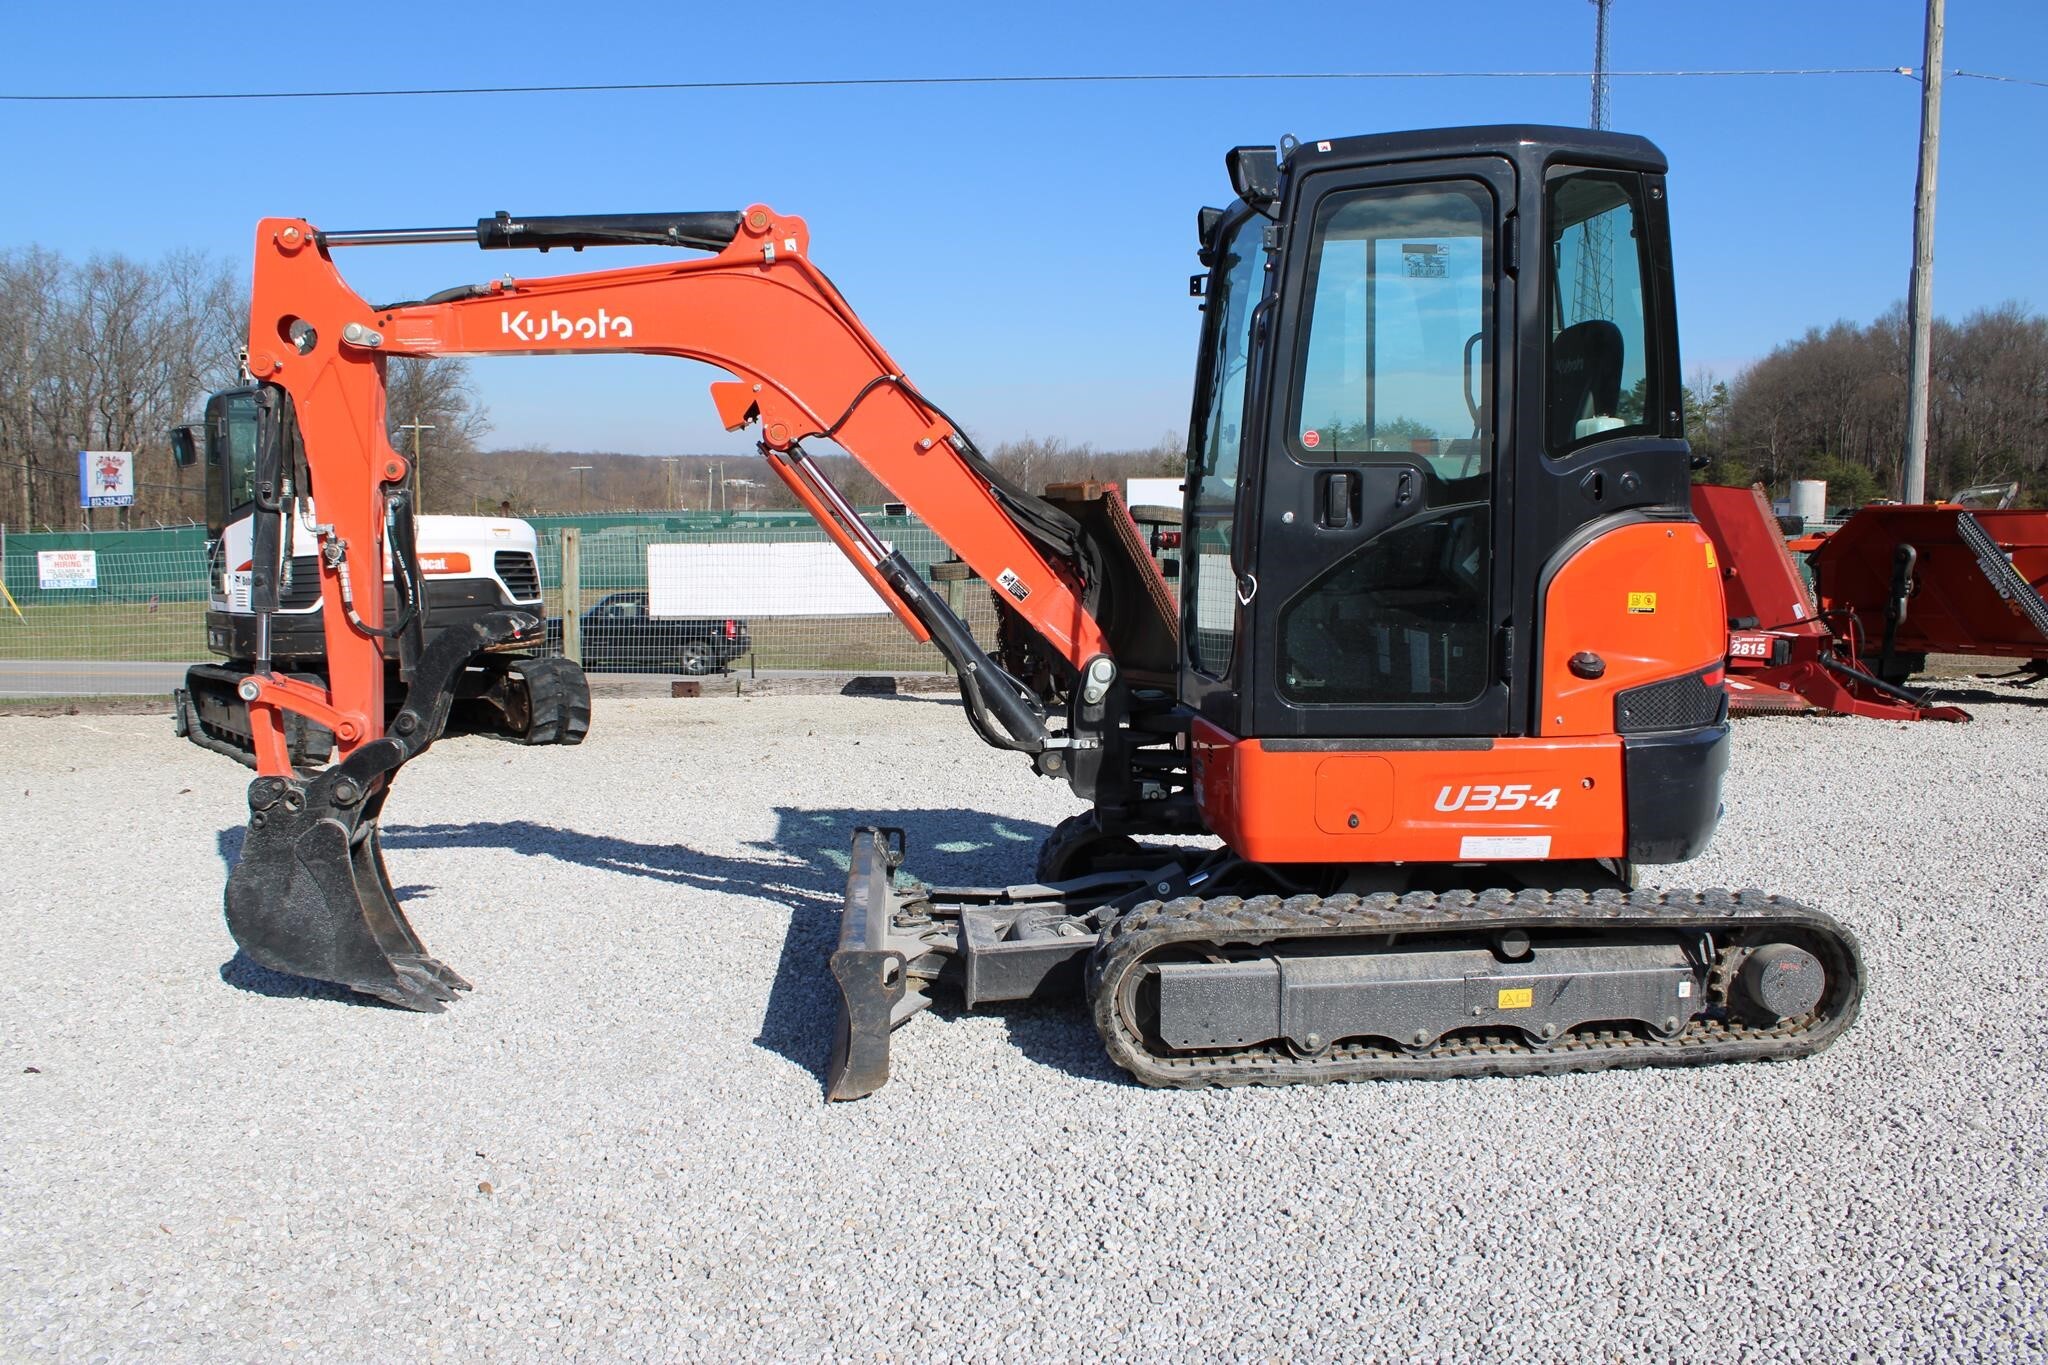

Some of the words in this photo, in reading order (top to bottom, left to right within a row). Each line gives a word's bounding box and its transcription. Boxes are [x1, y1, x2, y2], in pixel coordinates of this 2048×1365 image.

[501, 308, 633, 341] Kubota
[57, 553, 77, 561] NOW
[1731, 643, 1766, 656] 2815
[1434, 784, 1562, 812] U35-4
